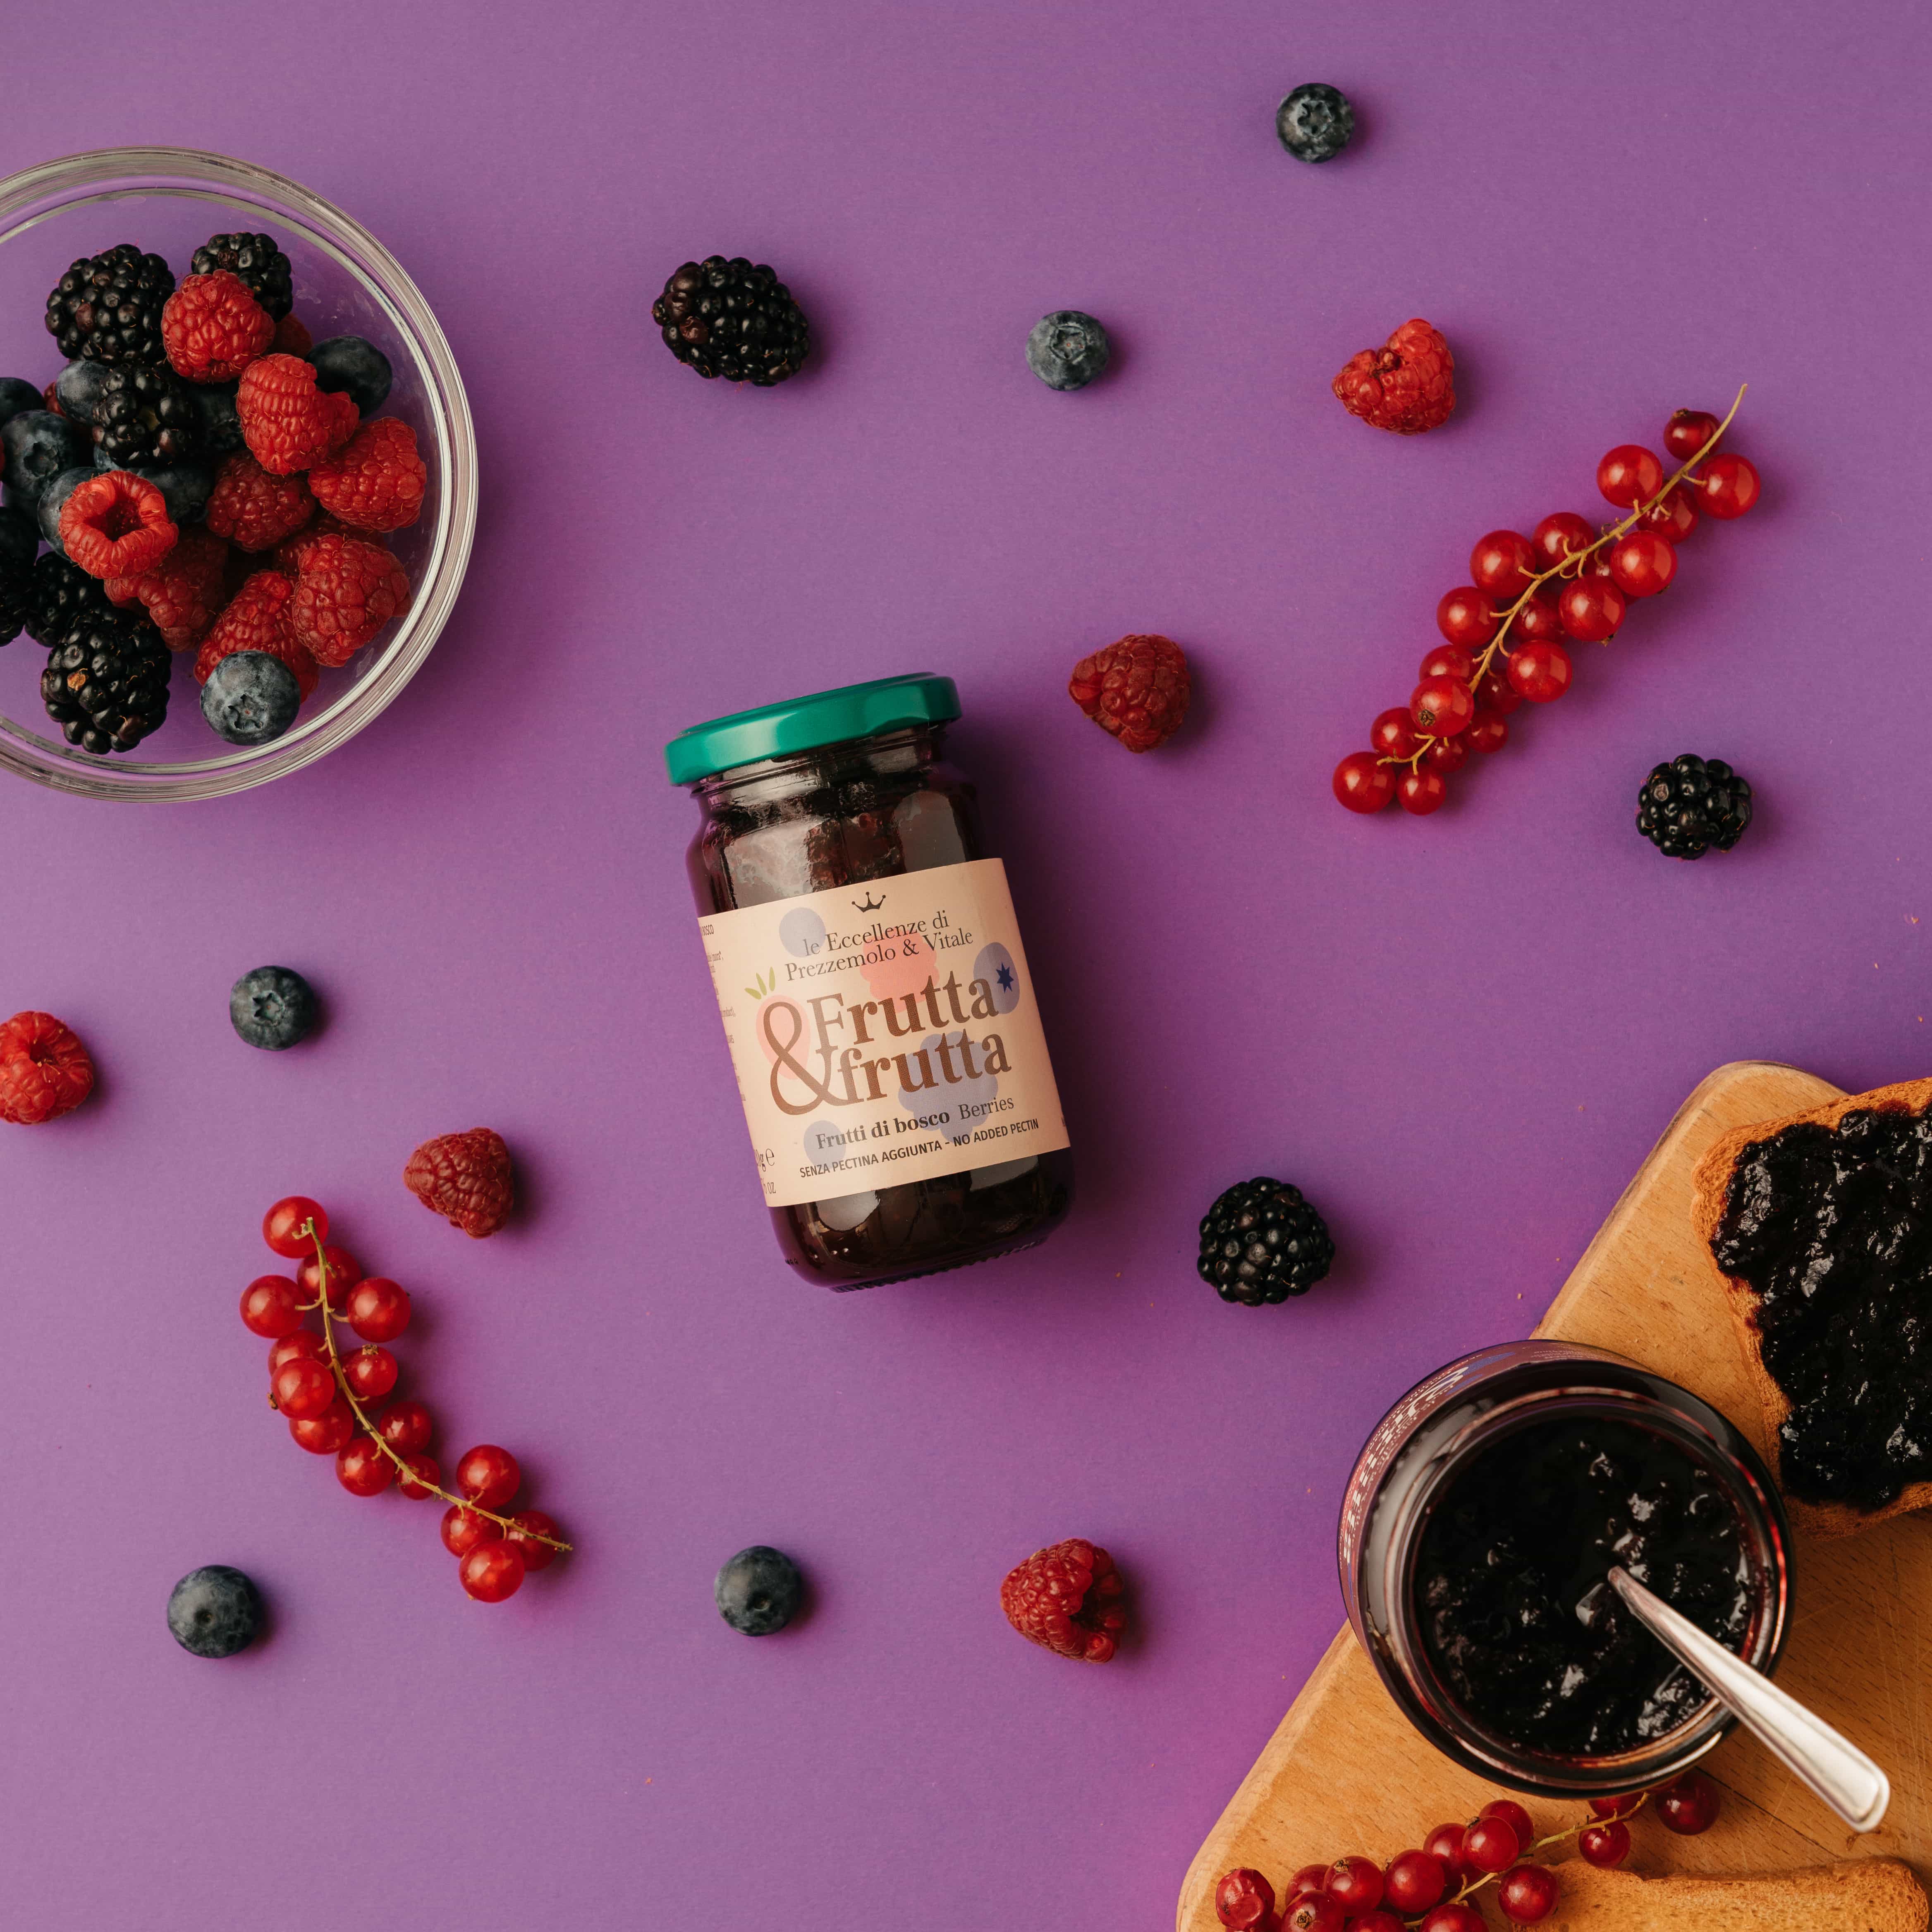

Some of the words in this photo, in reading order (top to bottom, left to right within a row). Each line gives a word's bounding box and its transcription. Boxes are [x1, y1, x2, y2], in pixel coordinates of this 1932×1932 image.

[784, 944, 896, 981] Prezzemolo
[903, 939, 920, 957] &
[922, 928, 973, 952] Vitale
[802, 939, 821, 956] le
[825, 919, 927, 952] Eccellenze
[932, 910, 950, 929] di
[807, 971, 999, 1050] Frutta
[837, 1028, 1012, 1104] frutta
[799, 1164, 830, 1178] SENZA
[832, 1153, 879, 1172] PECTINA
[881, 1140, 943, 1163] AGGIUNTA
[952, 1133, 971, 1147] NO
[973, 1126, 1008, 1143] ADDED
[1010, 1118, 1039, 1134] PECTIN
[815, 1125, 867, 1149] Frutti
[871, 1120, 891, 1138] di
[893, 1112, 950, 1133] bosco
[958, 1097, 1014, 1120] Berries
